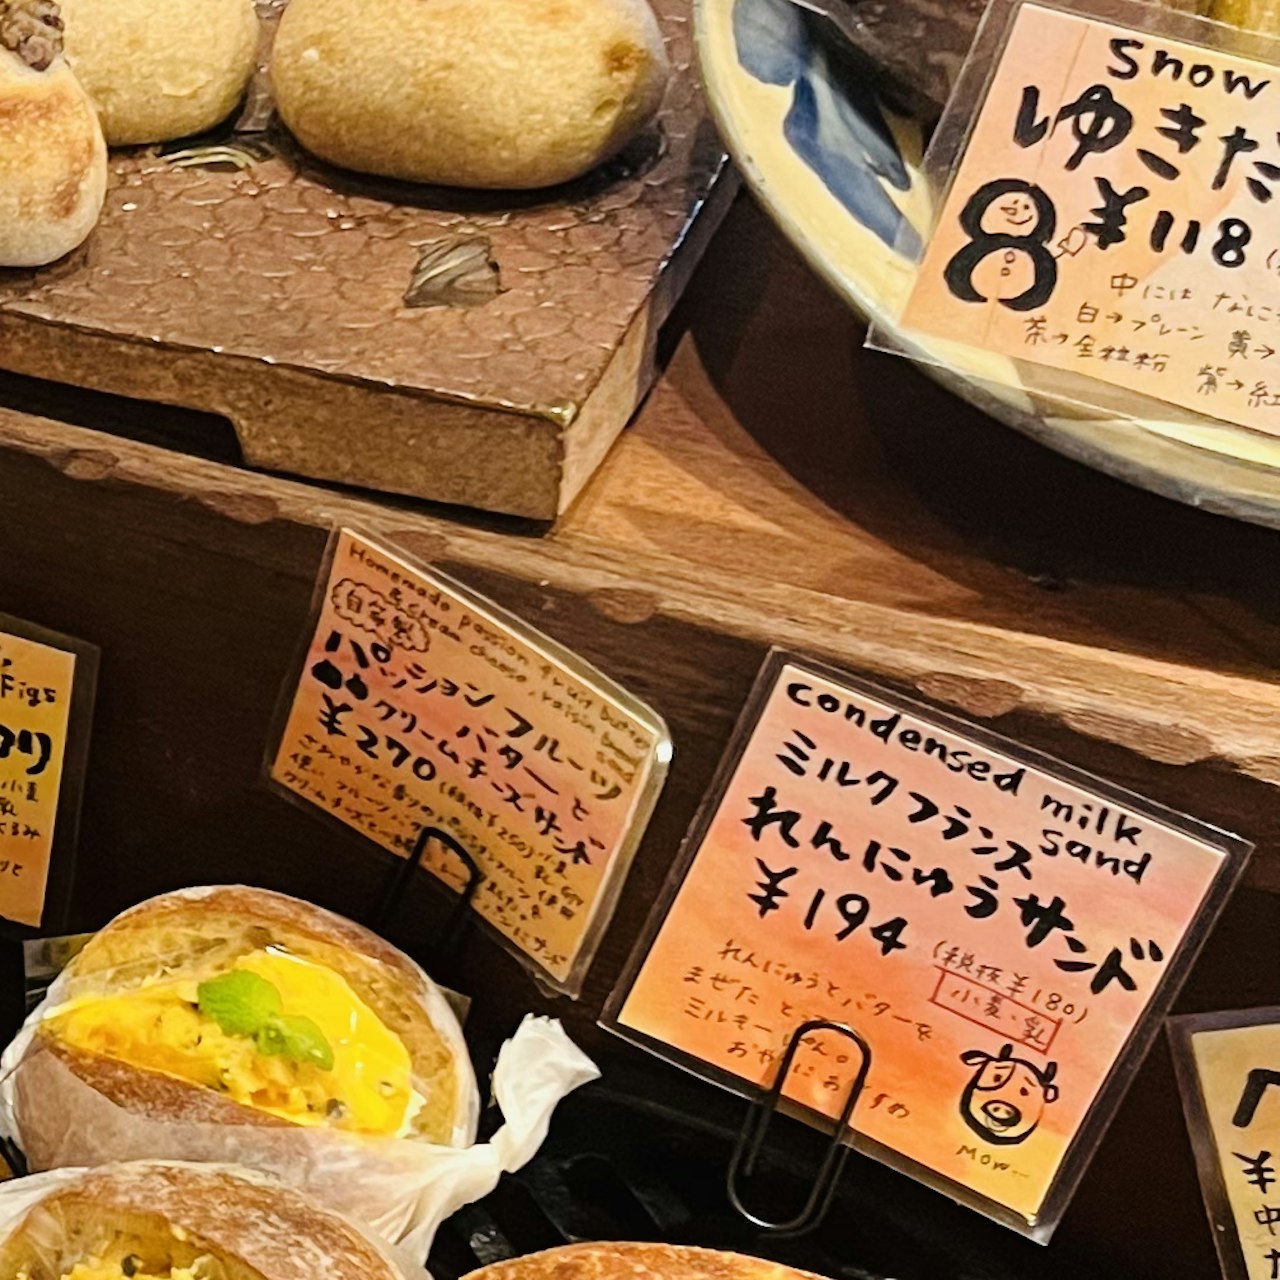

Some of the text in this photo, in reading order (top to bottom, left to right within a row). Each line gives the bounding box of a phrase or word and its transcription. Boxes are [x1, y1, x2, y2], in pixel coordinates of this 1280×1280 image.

[1106, 37, 1271, 101] Snow
[1081, 176, 1254, 268] ¥118
[348, 541, 453, 613] Homemade
[457, 613, 530, 668] passion
[407, 601, 463, 644] cream
[0, 674, 58, 708] Figs
[317, 693, 438, 782] ¥270
[784, 680, 1145, 848] condensed milk
[773, 727, 1036, 882] ミルクフランス
[739, 783, 1166, 998] れんにゅうサンド
[1037, 825, 1155, 887] sand
[744, 856, 1094, 1027] ¥194 (税抜¥180)
